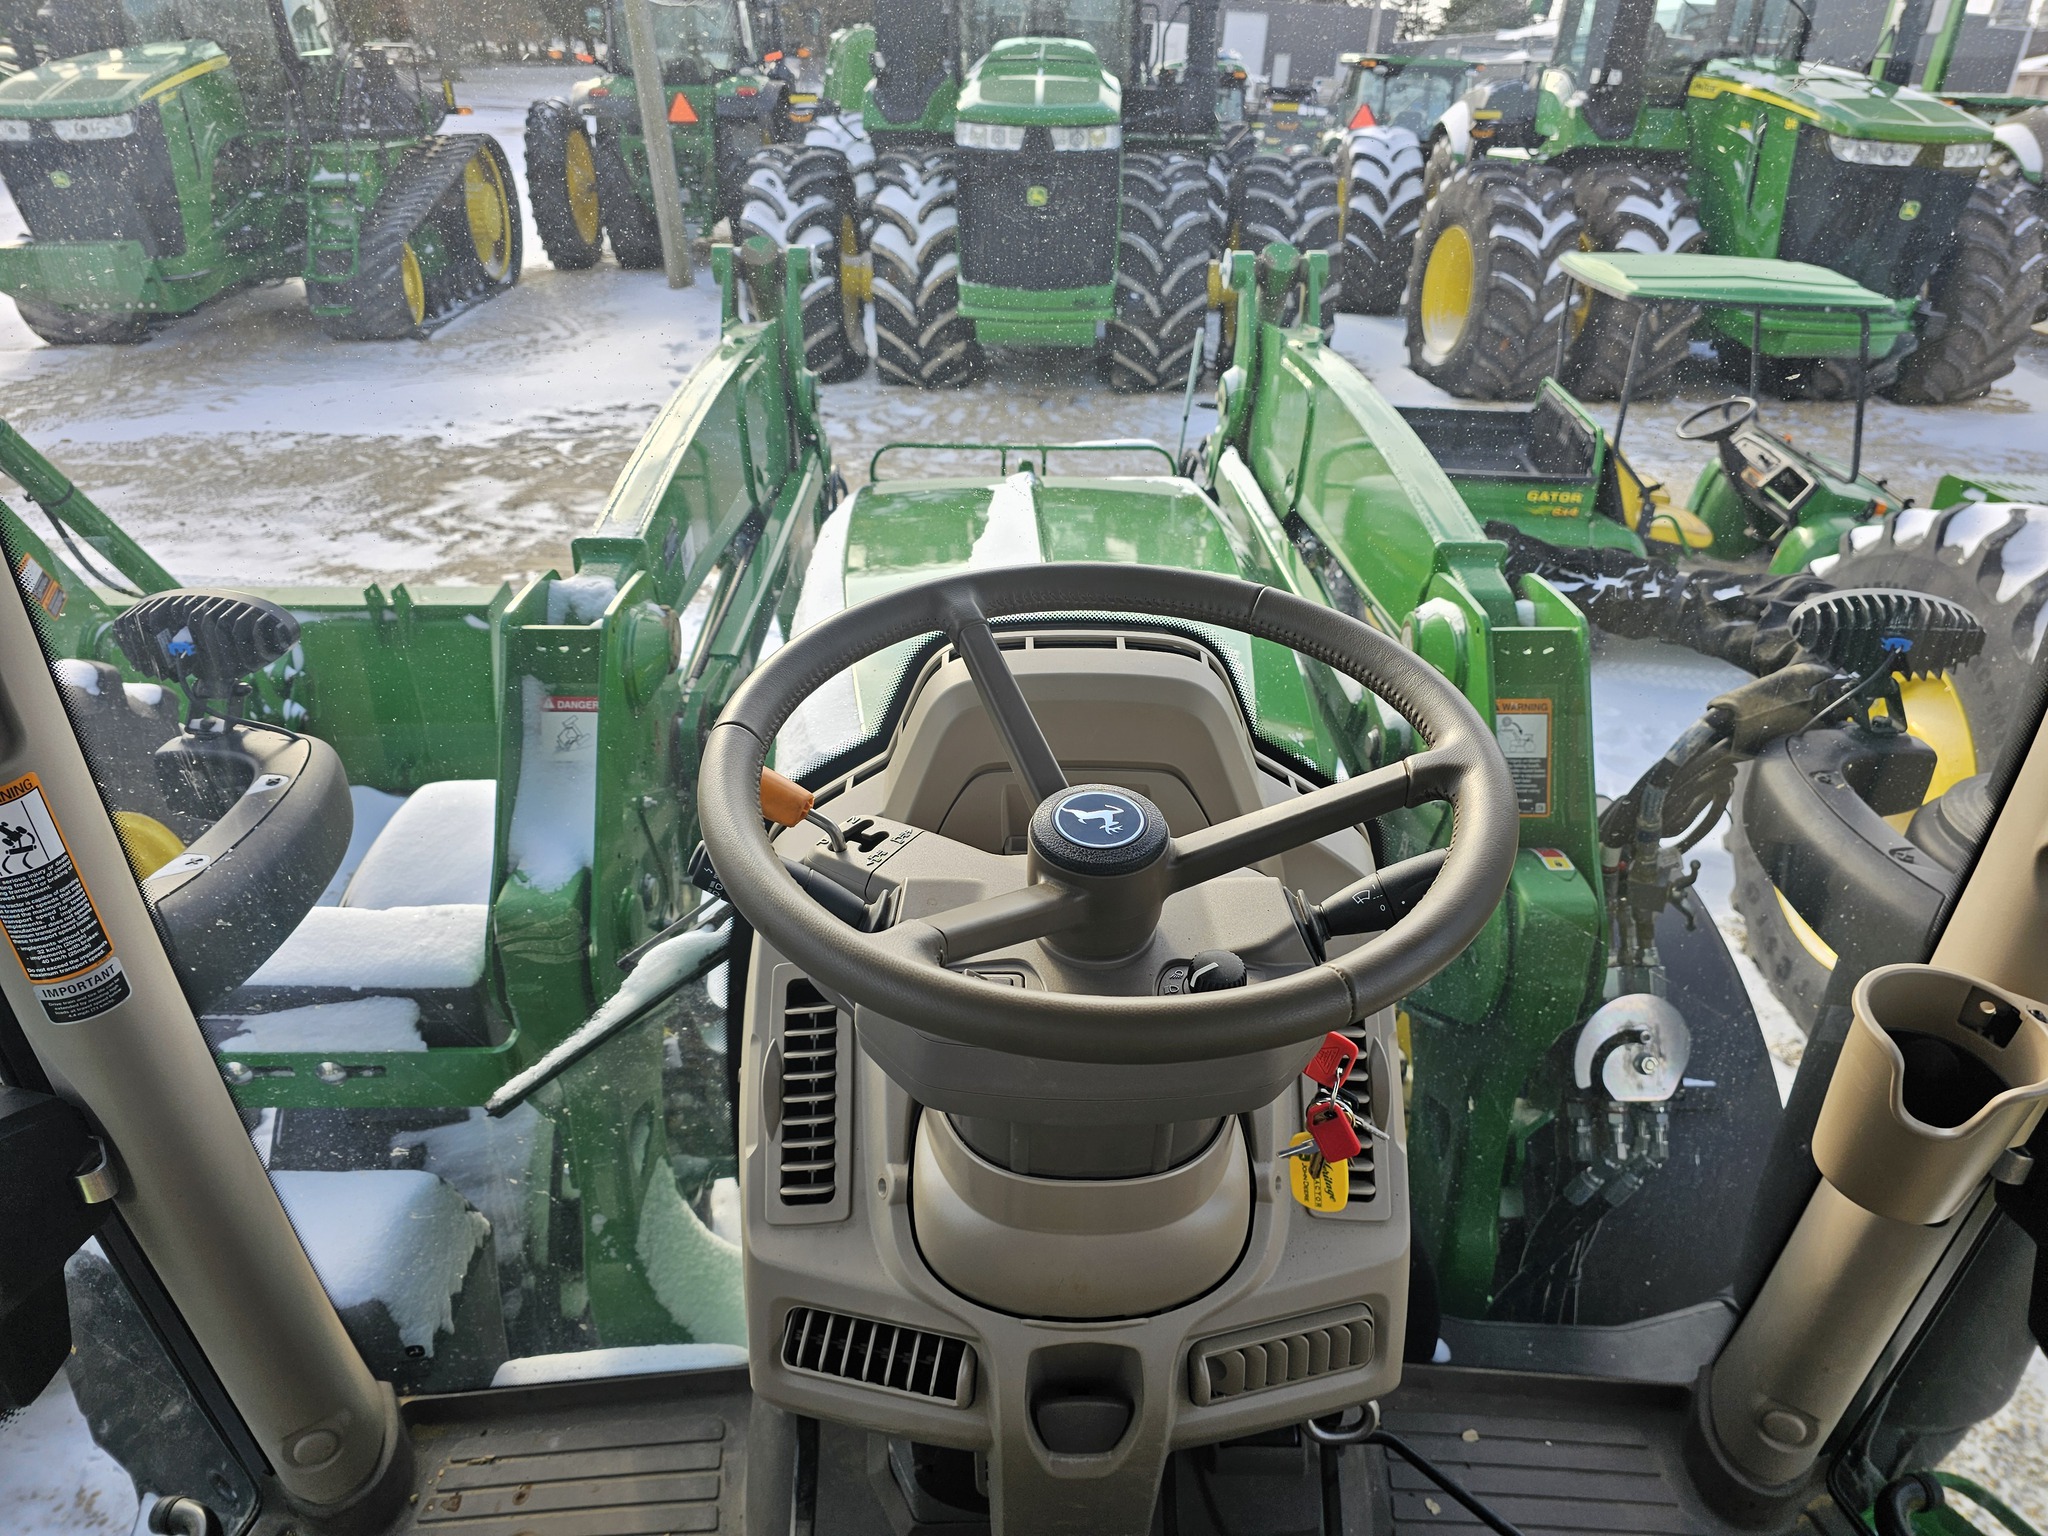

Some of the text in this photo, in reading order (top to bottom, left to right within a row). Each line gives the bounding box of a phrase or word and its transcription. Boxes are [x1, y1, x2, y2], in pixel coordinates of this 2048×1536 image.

[1526, 489, 1583, 504] GATOR
[557, 700, 599, 709] DANGER
[1502, 703, 1548, 711] WARNING
[0, 778, 33, 803] NING
[2, 876, 26, 885] serious
[28, 869, 46, 879] injury
[55, 854, 69, 867] death
[14, 880, 30, 889] from
[31, 875, 45, 883] loss
[54, 859, 71, 873] control
[8, 883, 39, 895] transport
[47, 869, 69, 883] braking
[16, 885, 52, 899] implement.
[31, 894, 53, 904] capable
[59, 877, 79, 893] operating
[4, 905, 35, 914] transport
[35, 897, 59, 908] speeds
[59, 889, 71, 899] that
[71, 883, 81, 892] may
[32, 902, 61, 915] maximum
[62, 887, 83, 904] allowable
[35, 909, 57, 920] speed
[70, 891, 86, 905] towed
[60, 896, 88, 917] implement
[8, 902, 90, 934] manufacturer does not specify
[20, 941, 57, 951] implements
[57, 931, 80, 944] without
[29, 932, 58, 943] transport
[58, 924, 77, 935] speed
[35, 925, 60, 937] transport
[30, 949, 67, 960] implements
[67, 943, 80, 951] with
[45, 944, 63, 953] km/h
[63, 933, 87, 948] (20mph)
[50, 954, 68, 962] km/h
[68, 942, 92, 957] (25mph)
[29, 970, 59, 978] maximum
[59, 960, 88, 974] transport
[46, 961, 69, 971] exceed
[42, 964, 115, 998] IMPORTANT
[77, 1003, 93, 1012] travel
